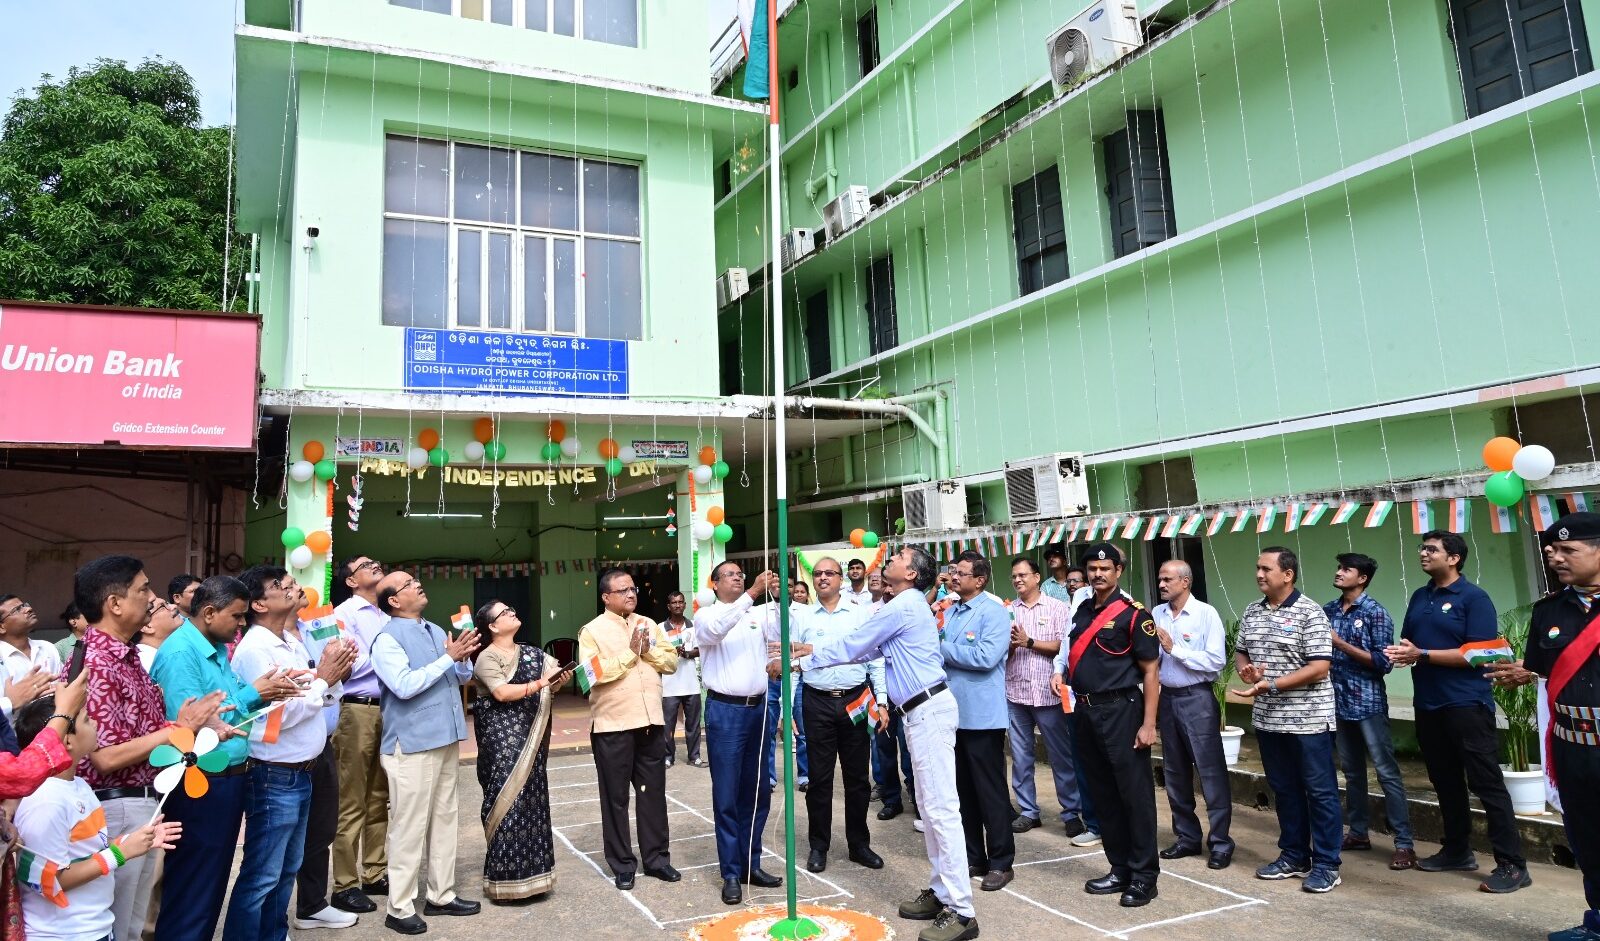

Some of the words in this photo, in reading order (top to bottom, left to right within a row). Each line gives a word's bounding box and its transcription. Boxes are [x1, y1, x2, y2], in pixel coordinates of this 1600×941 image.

[415, 342, 436, 351] OHPC
[1, 344, 94, 374] Union
[103, 349, 183, 378] Bank
[414, 365, 454, 374] ODISHA
[457, 366, 492, 376] HYDRO
[496, 368, 530, 378] POWER
[532, 370, 600, 381] CORPORATION
[602, 372, 621, 382] LTD.
[122, 383, 142, 398] of
[142, 384, 182, 399] India
[112, 422, 142, 434] Gridco
[144, 423, 188, 435] Extension
[191, 424, 226, 436] Counter
[361, 441, 400, 453] INDIA
[444, 466, 596, 486] INDEPENDENCE
[630, 460, 656, 477] DAY
